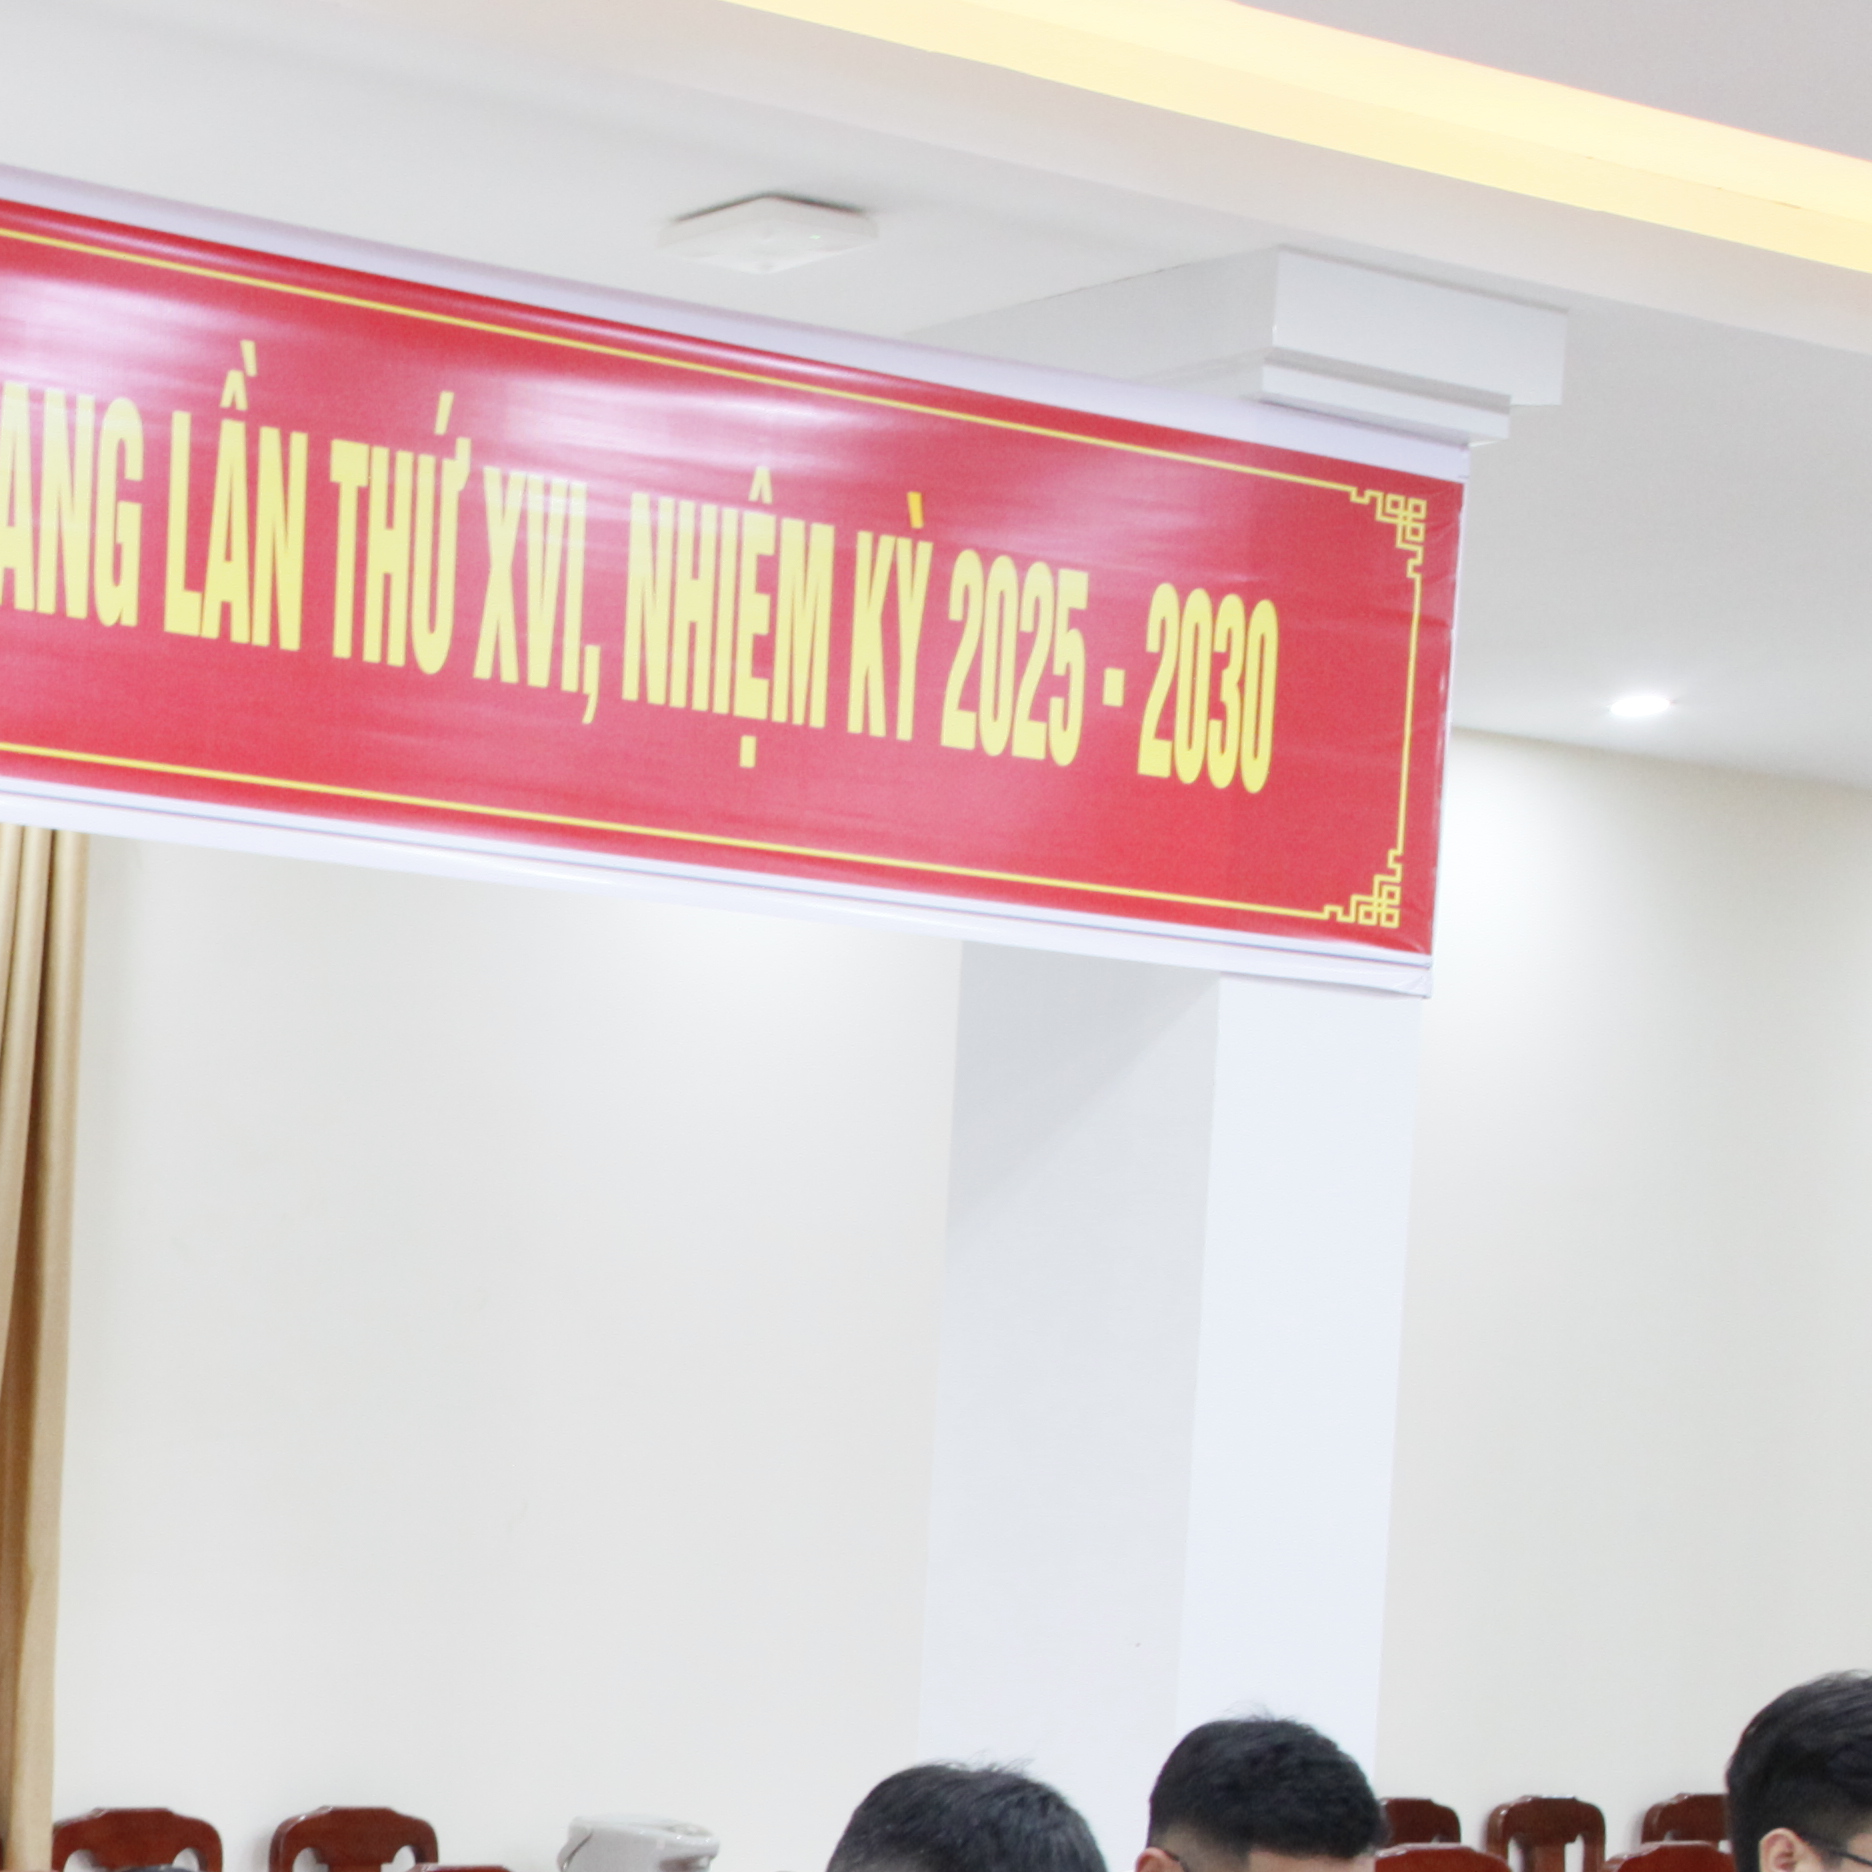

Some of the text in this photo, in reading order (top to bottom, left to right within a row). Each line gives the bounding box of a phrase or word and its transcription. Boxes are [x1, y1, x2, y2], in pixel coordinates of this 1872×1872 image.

[163, 339, 309, 652] LẦN
[329, 390, 471, 676] THỨ
[472, 465, 602, 725] XVI,
[621, 465, 836, 769] NHIỆM
[846, 491, 933, 742] KỲ
[940, 549, 1089, 766] 2025
[1137, 582, 1279, 794] 2030
